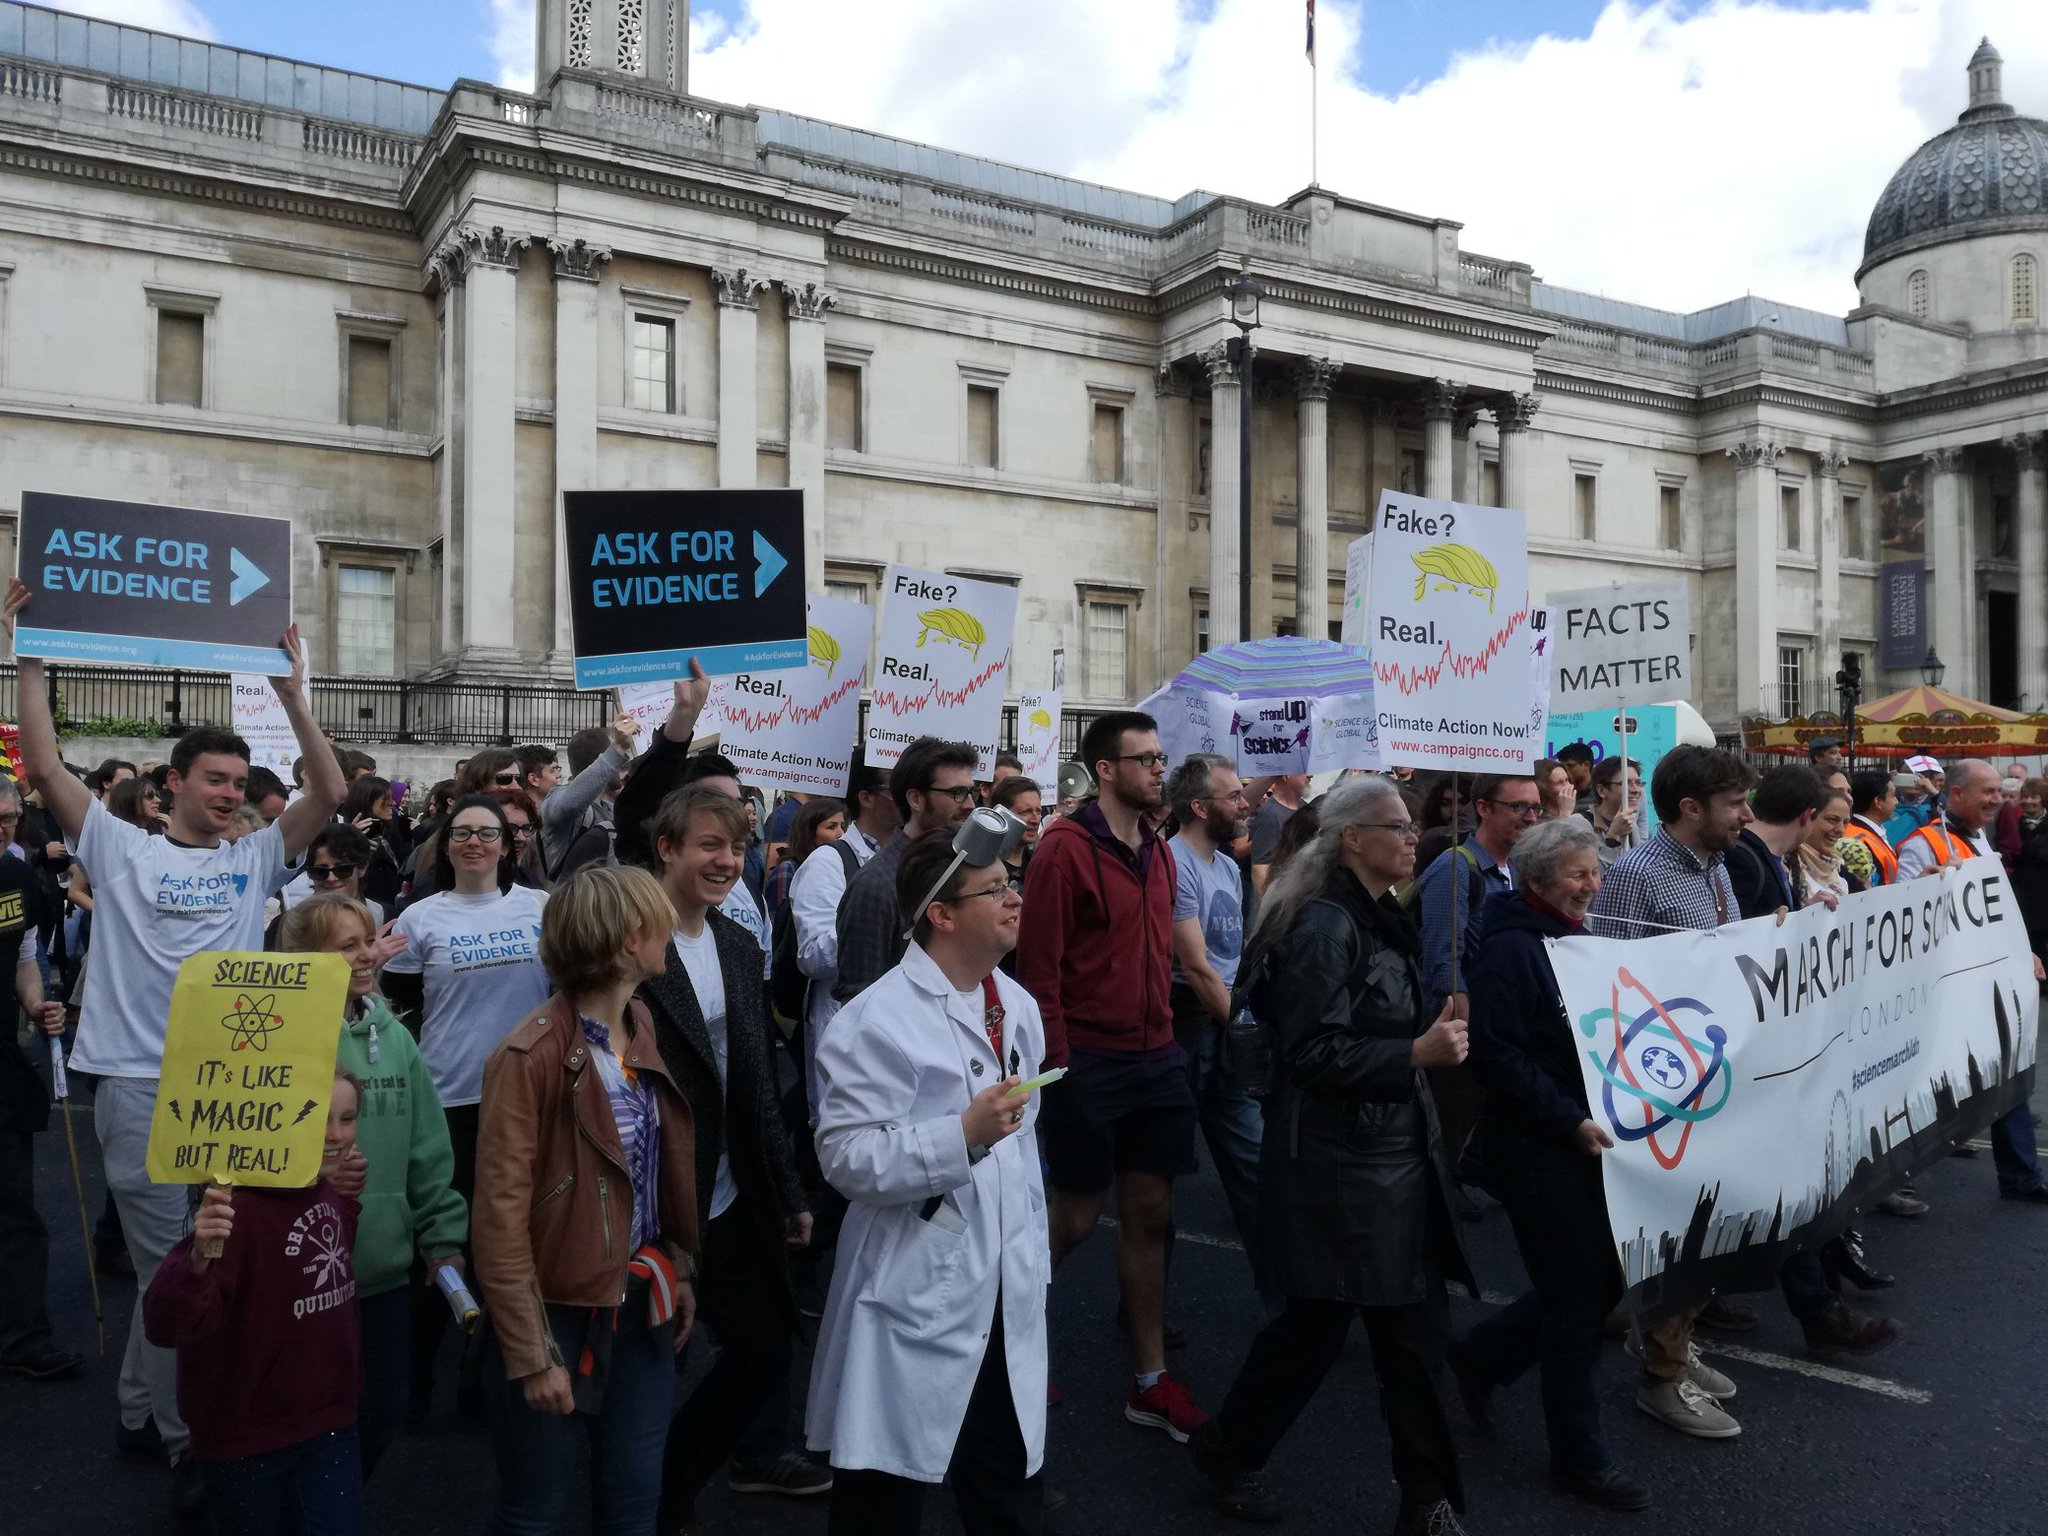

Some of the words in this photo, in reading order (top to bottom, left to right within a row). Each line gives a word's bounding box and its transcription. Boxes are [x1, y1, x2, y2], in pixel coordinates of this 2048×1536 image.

[1383, 504, 1455, 537] Fake?
[44, 528, 123, 561] ASK
[135, 537, 209, 570] FOR
[591, 531, 660, 566] ASK
[670, 530, 735, 563] FOR
[43, 564, 211, 604] EVIDENCE
[592, 573, 739, 608] EVIDENCE
[895, 575, 957, 603] Fake?
[1380, 616, 1443, 645] Real.
[1566, 600, 1670, 640] FACTS
[23, 637, 138, 655] www.askforevidence.org
[744, 649, 803, 663] #AskforEvidence
[583, 661, 681, 678] www.askforevidence.org
[882, 657, 933, 682] Real.
[1560, 655, 1682, 692] MATTER
[236, 685, 268, 696] Real.
[735, 675, 786, 698] Real.
[1021, 697, 1042, 707] Fake?
[1260, 709, 1284, 721] stand
[1334, 718, 1361, 728] SCIENCE
[1378, 712, 1433, 733] Climate
[1438, 718, 1488, 736] Action
[1493, 721, 1530, 739] Now!
[235, 724, 263, 732] Climate
[265, 724, 290, 732] Action
[869, 728, 916, 745] Climate
[1336, 730, 1361, 739] GLOBAL
[720, 744, 768, 760] Climate
[771, 752, 812, 767] Action
[816, 757, 848, 772] Now!
[1020, 744, 1037, 755] Real.
[1391, 739, 1524, 762] www.campaigncc.org
[160, 872, 194, 891] ASK
[197, 872, 230, 890] FOR
[156, 890, 230, 907] EVIDENCE
[1211, 916, 1242, 931] NASA
[450, 934, 485, 948] ASK
[488, 929, 525, 944] FOR
[451, 943, 532, 965] EVIDENCE
[454, 957, 534, 973] www.askforevidence.org
[1734, 921, 1854, 1023] MARCH
[1863, 906, 1914, 976] FOR
[214, 959, 311, 986] SCIENCE
[1848, 983, 1927, 1043] LONDON
[242, 1065, 293, 1090] LIKE
[381, 1076, 395, 1089] cat
[190, 1099, 284, 1136] MAGIC
[174, 1142, 219, 1173] BUT
[227, 1143, 290, 1175] REAL!
